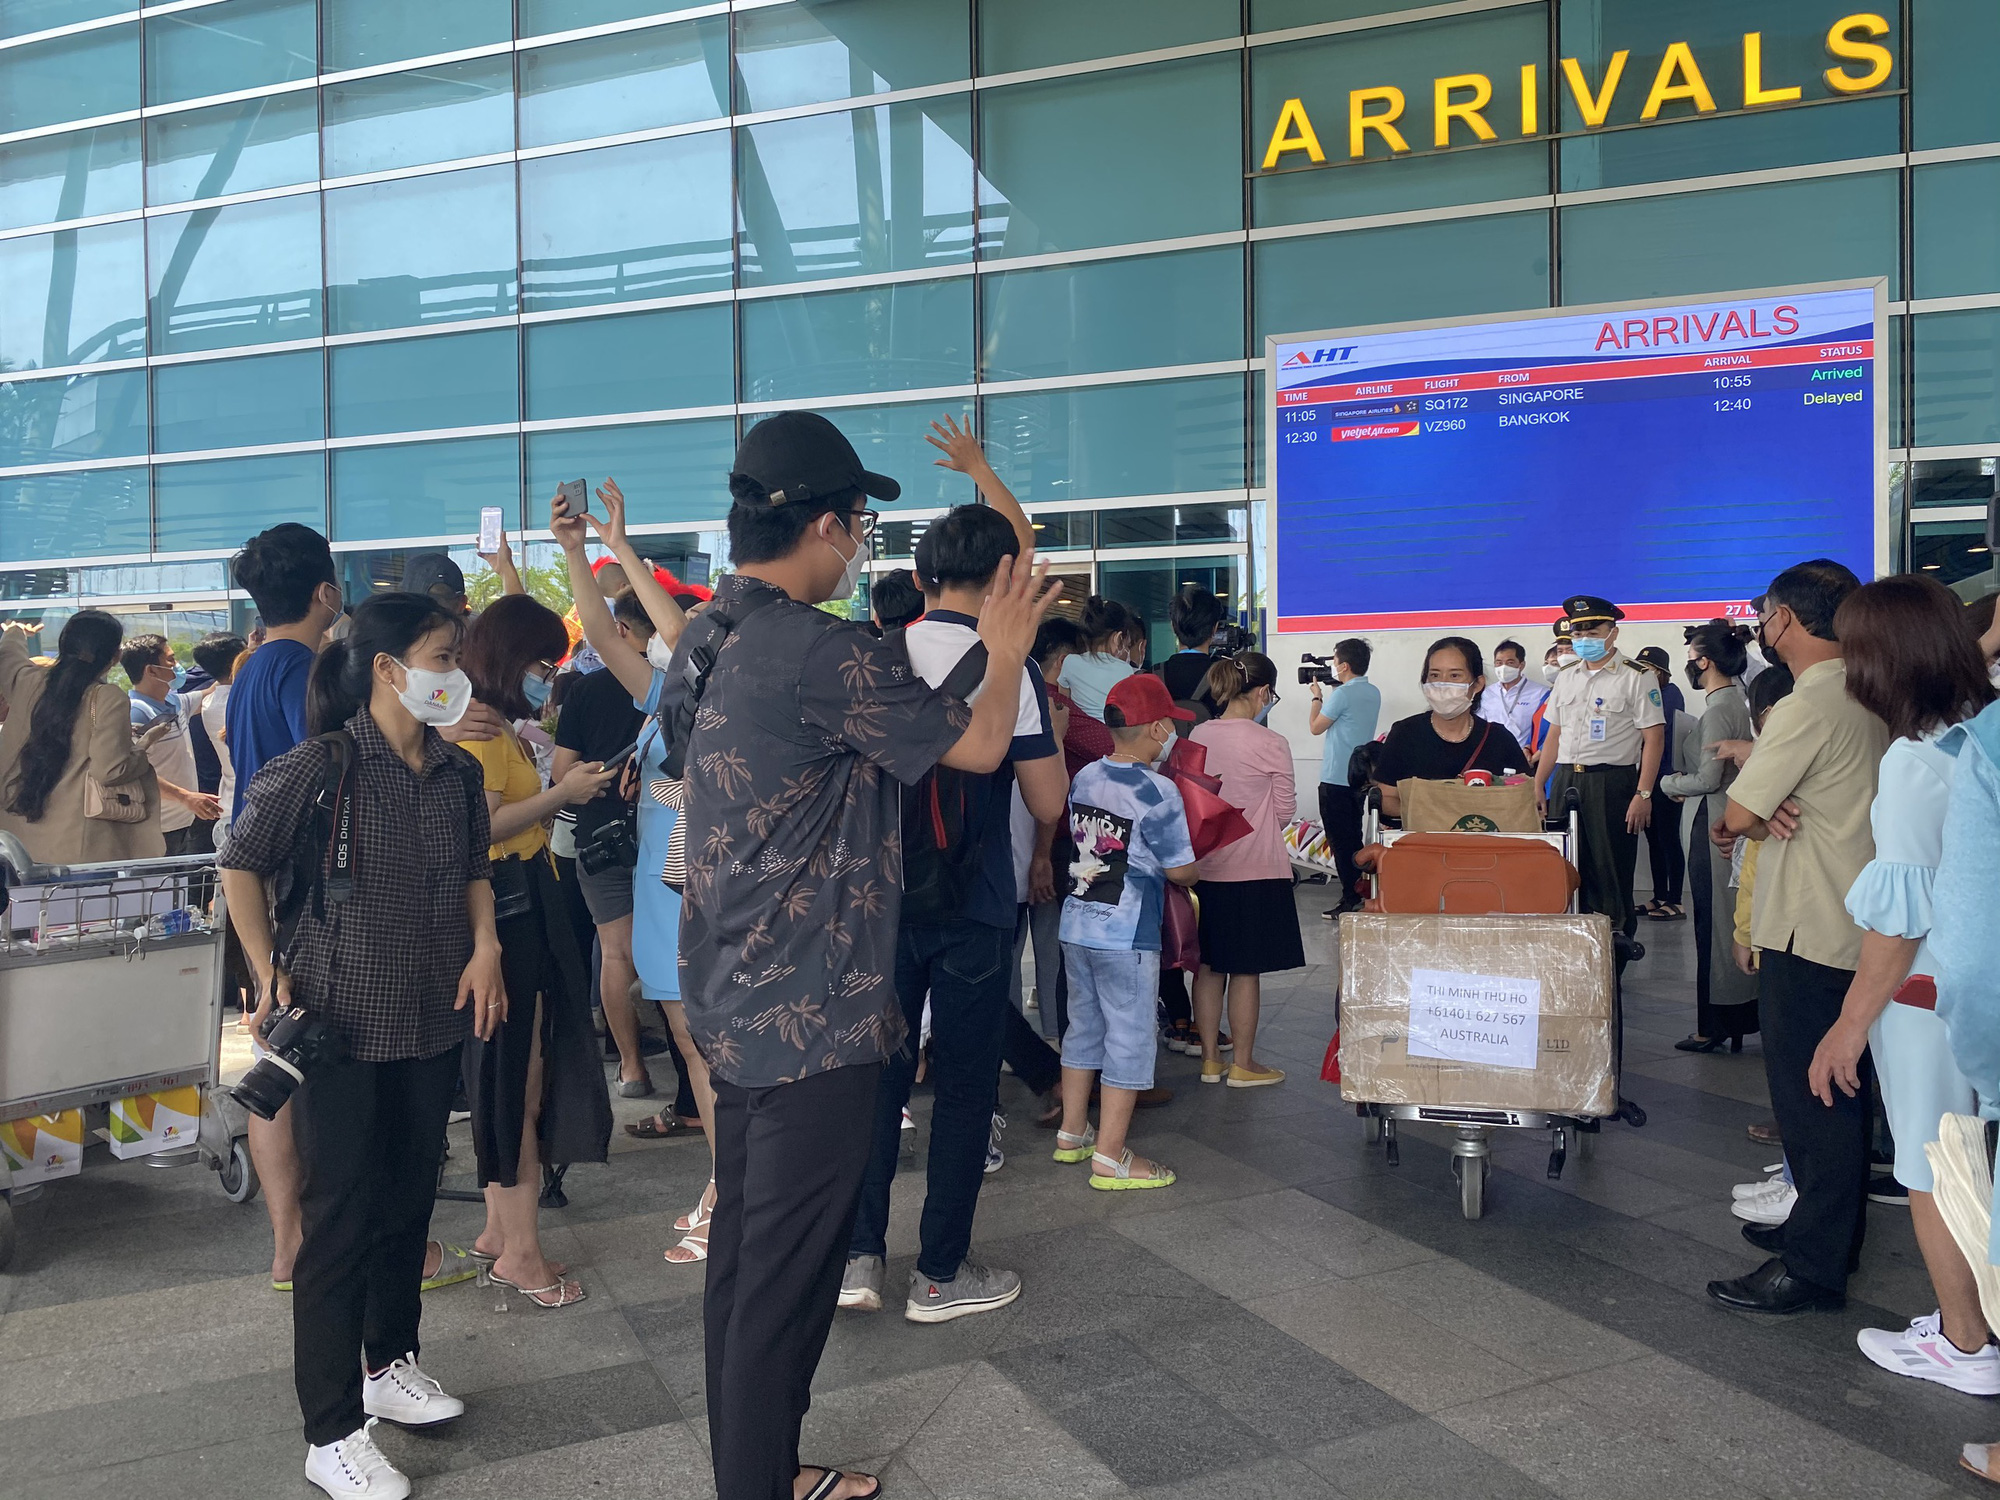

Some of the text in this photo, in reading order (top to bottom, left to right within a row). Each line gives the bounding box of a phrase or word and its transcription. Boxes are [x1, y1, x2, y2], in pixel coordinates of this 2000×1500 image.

[1261, 12, 1893, 170] ARRIVALS
[1594, 305, 1800, 351] ARRIVALS
[1282, 346, 1359, 367] AHT
[1284, 345, 1863, 402] TIME AIRLINE FLIGHT FROM ARRIVAL STATUS
[1284, 366, 1863, 423] 11:05 SINGAPORE AIRLINES SQ172 SINGAPORE 10:55 Arrived
[1284, 431, 1317, 444] 12:30
[1424, 418, 1466, 433] VZ960
[1499, 411, 1570, 427] BANGKOK
[1713, 398, 1752, 412] 12:40
[1804, 389, 1863, 407] Delayed
[1725, 604, 1742, 616] 27
[337, 794, 350, 869] EOS DIGITAL
[1427, 985, 1528, 1005] THI MINH THU HO
[1427, 1006, 1526, 1026] +61401 627 567
[1440, 1028, 1510, 1046] AUSTRALIA
[1546, 1039, 1570, 1049] LTD
